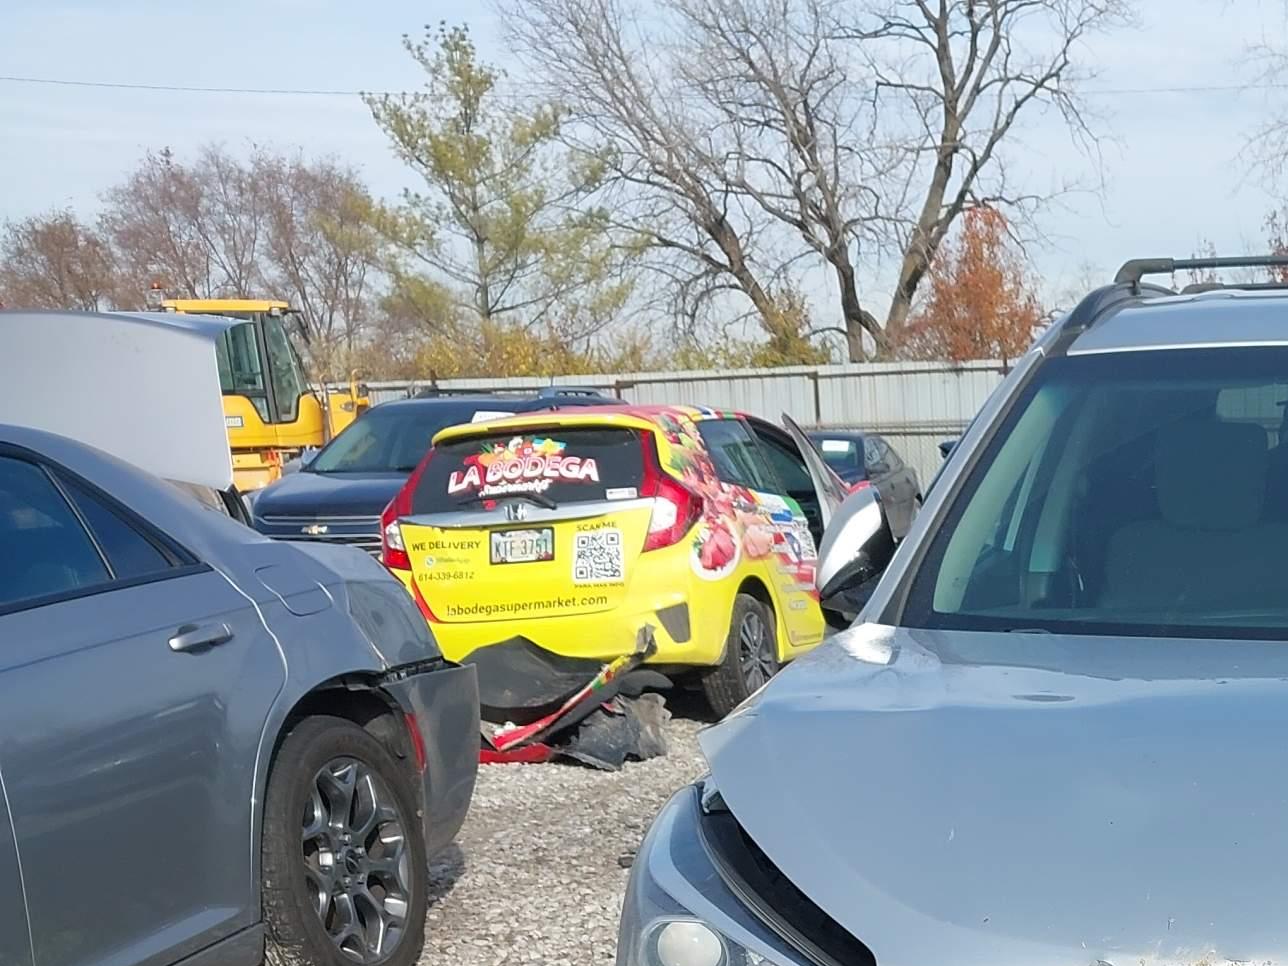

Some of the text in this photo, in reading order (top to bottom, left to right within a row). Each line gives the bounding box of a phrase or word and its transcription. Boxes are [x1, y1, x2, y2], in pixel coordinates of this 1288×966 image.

[448, 466, 481, 494] LA
[486, 456, 600, 483] BODEGA
[412, 541, 481, 551] WE DELIVERY
[447, 595, 608, 617] labodegasupermarket.com
